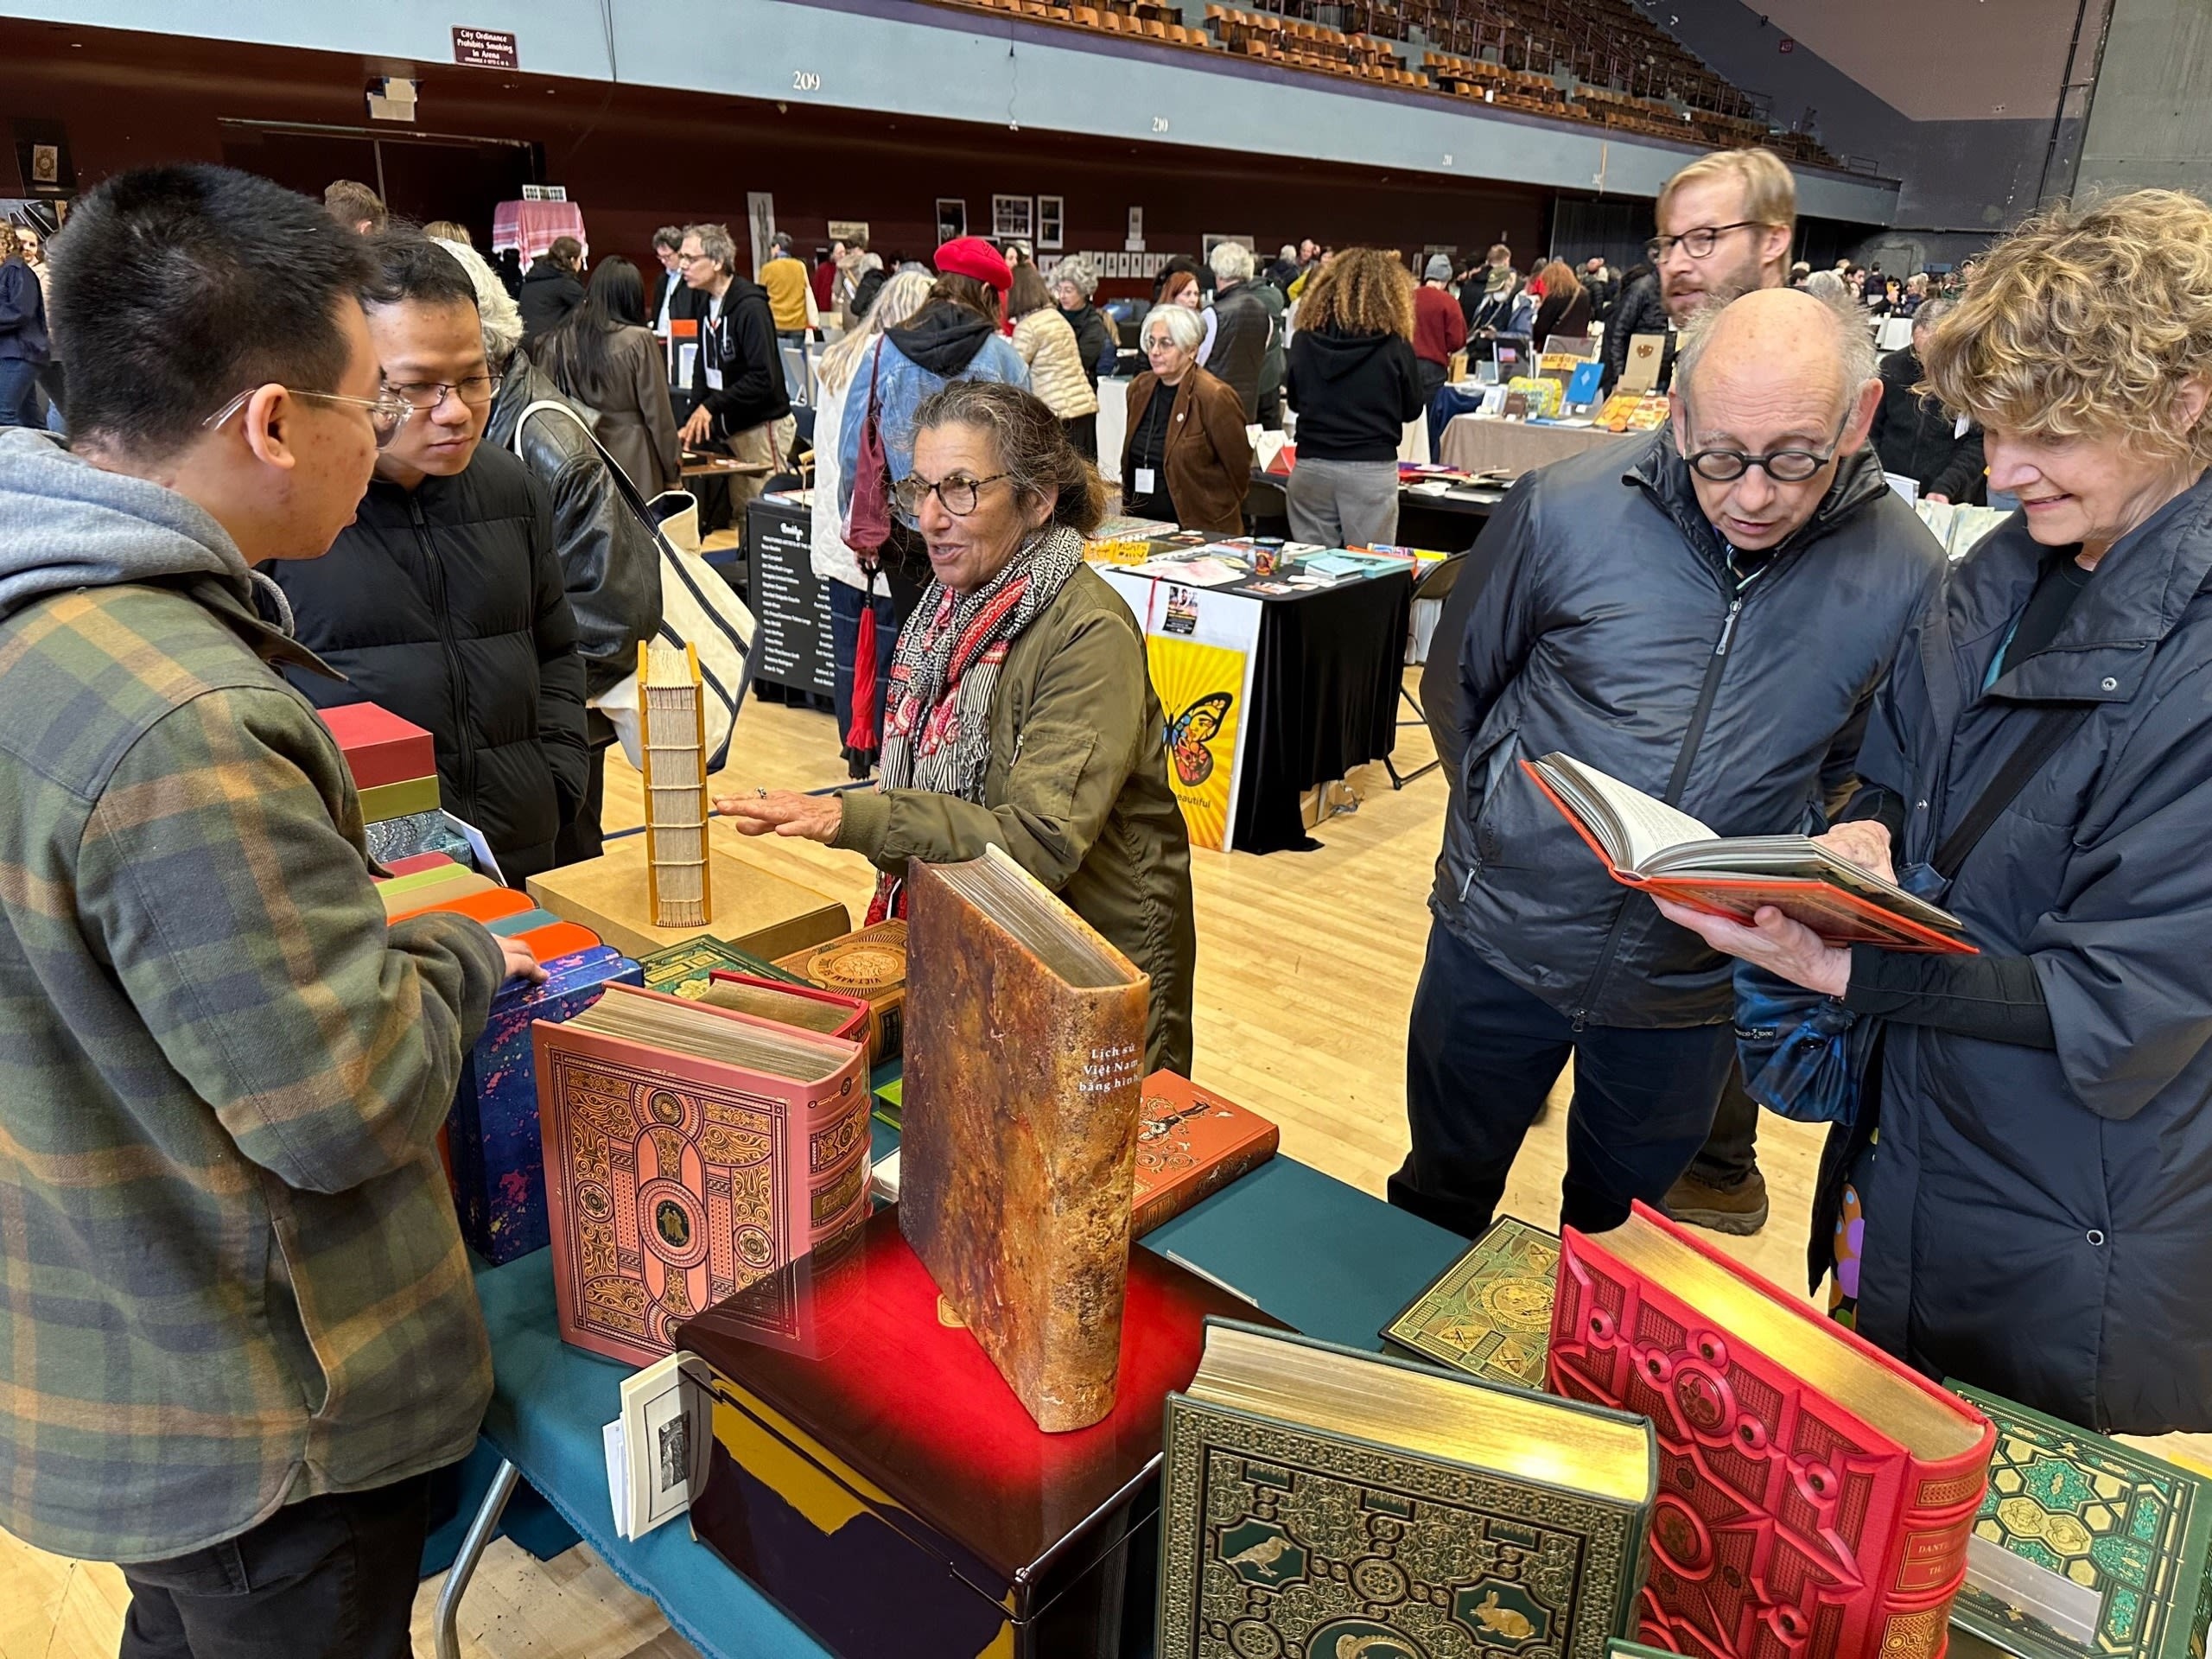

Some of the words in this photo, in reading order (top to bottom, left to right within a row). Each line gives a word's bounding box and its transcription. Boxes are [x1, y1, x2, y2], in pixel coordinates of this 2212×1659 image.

[461, 29, 474, 40] City
[475, 31, 507, 42] Ordinance
[457, 38, 484, 48] Prohibits
[486, 41, 513, 54] Smoking
[481, 50, 500, 60] Arena
[792, 70, 820, 91] 209
[1152, 117, 1169, 132] 210
[1177, 794, 1211, 809] eautiful
[1091, 1046, 1120, 1060] Lịch
[1084, 1065, 1111, 1077] Việt
[1114, 1059, 1138, 1072] Nam
